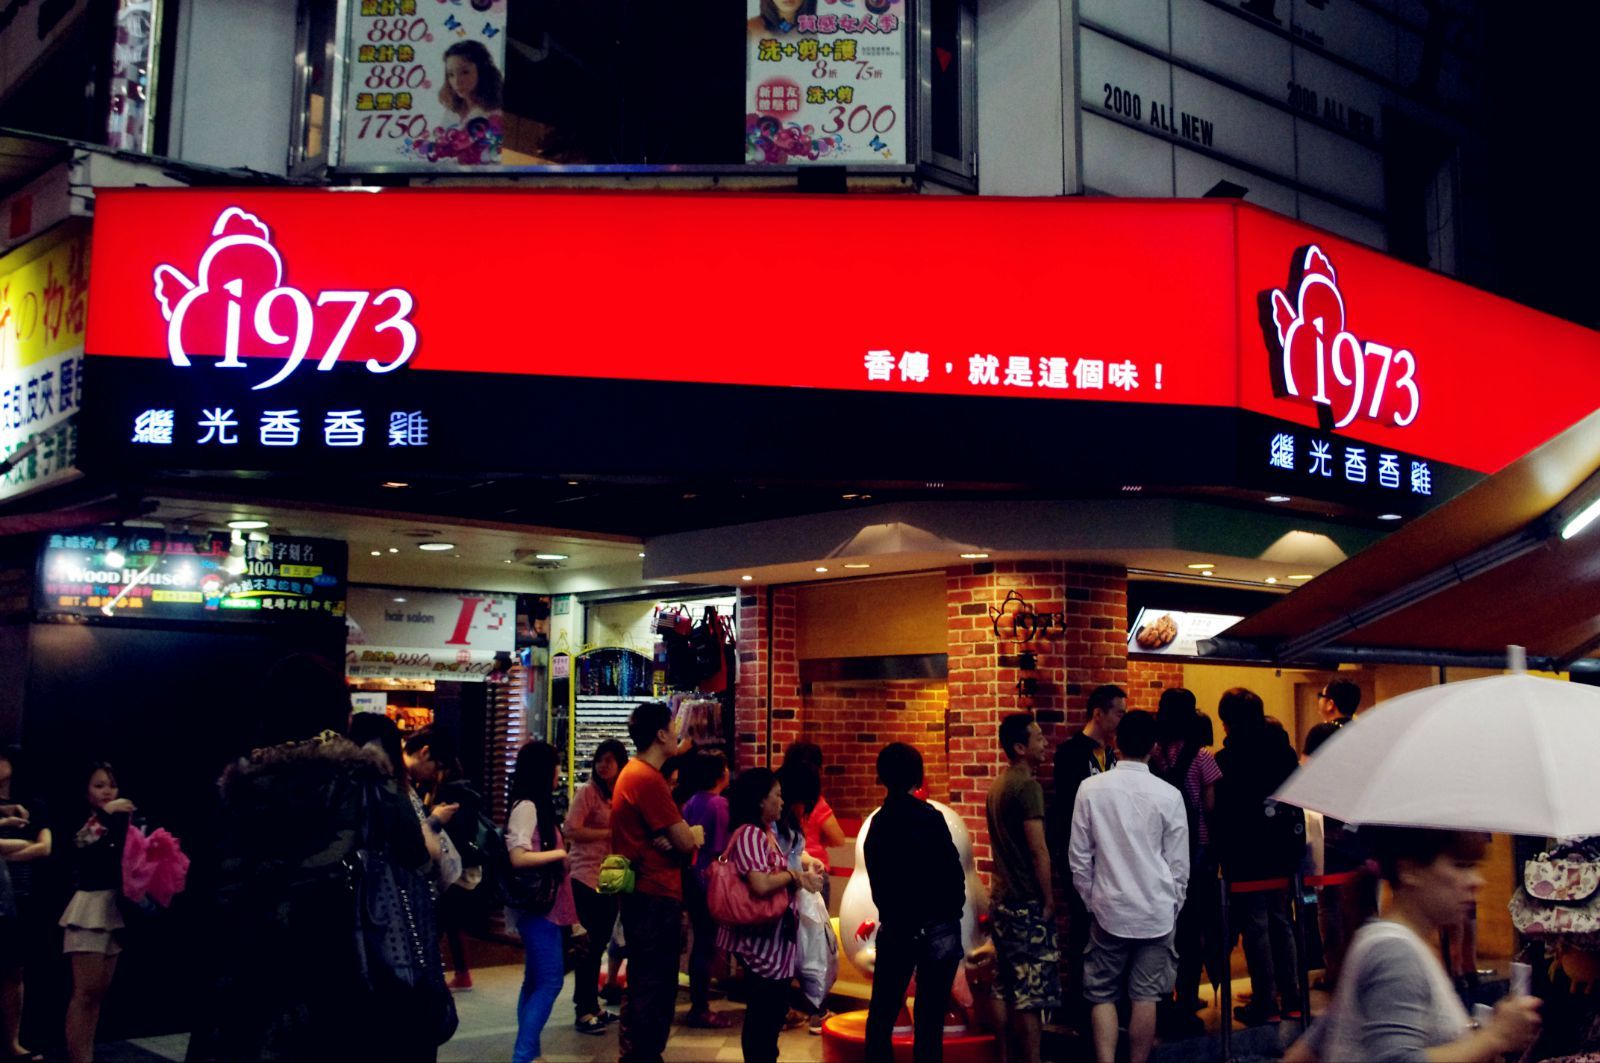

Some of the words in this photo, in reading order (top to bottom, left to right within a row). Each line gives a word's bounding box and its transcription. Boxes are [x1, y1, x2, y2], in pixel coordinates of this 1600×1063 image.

[367, 18, 428, 42] 880
[365, 64, 426, 89] 880
[357, 114, 428, 139] 1750
[821, 105, 896, 133] 300
[1103, 83, 1142, 121] 2000
[1150, 101, 1179, 136] ALL
[1181, 112, 1214, 147] NEW
[131, 407, 429, 446] 繼光香香雞
[1269, 433, 1432, 495] 繼光香香雞
[248, 561, 273, 576] 100
[384, 608, 404, 623] hair
[406, 611, 435, 624] salon
